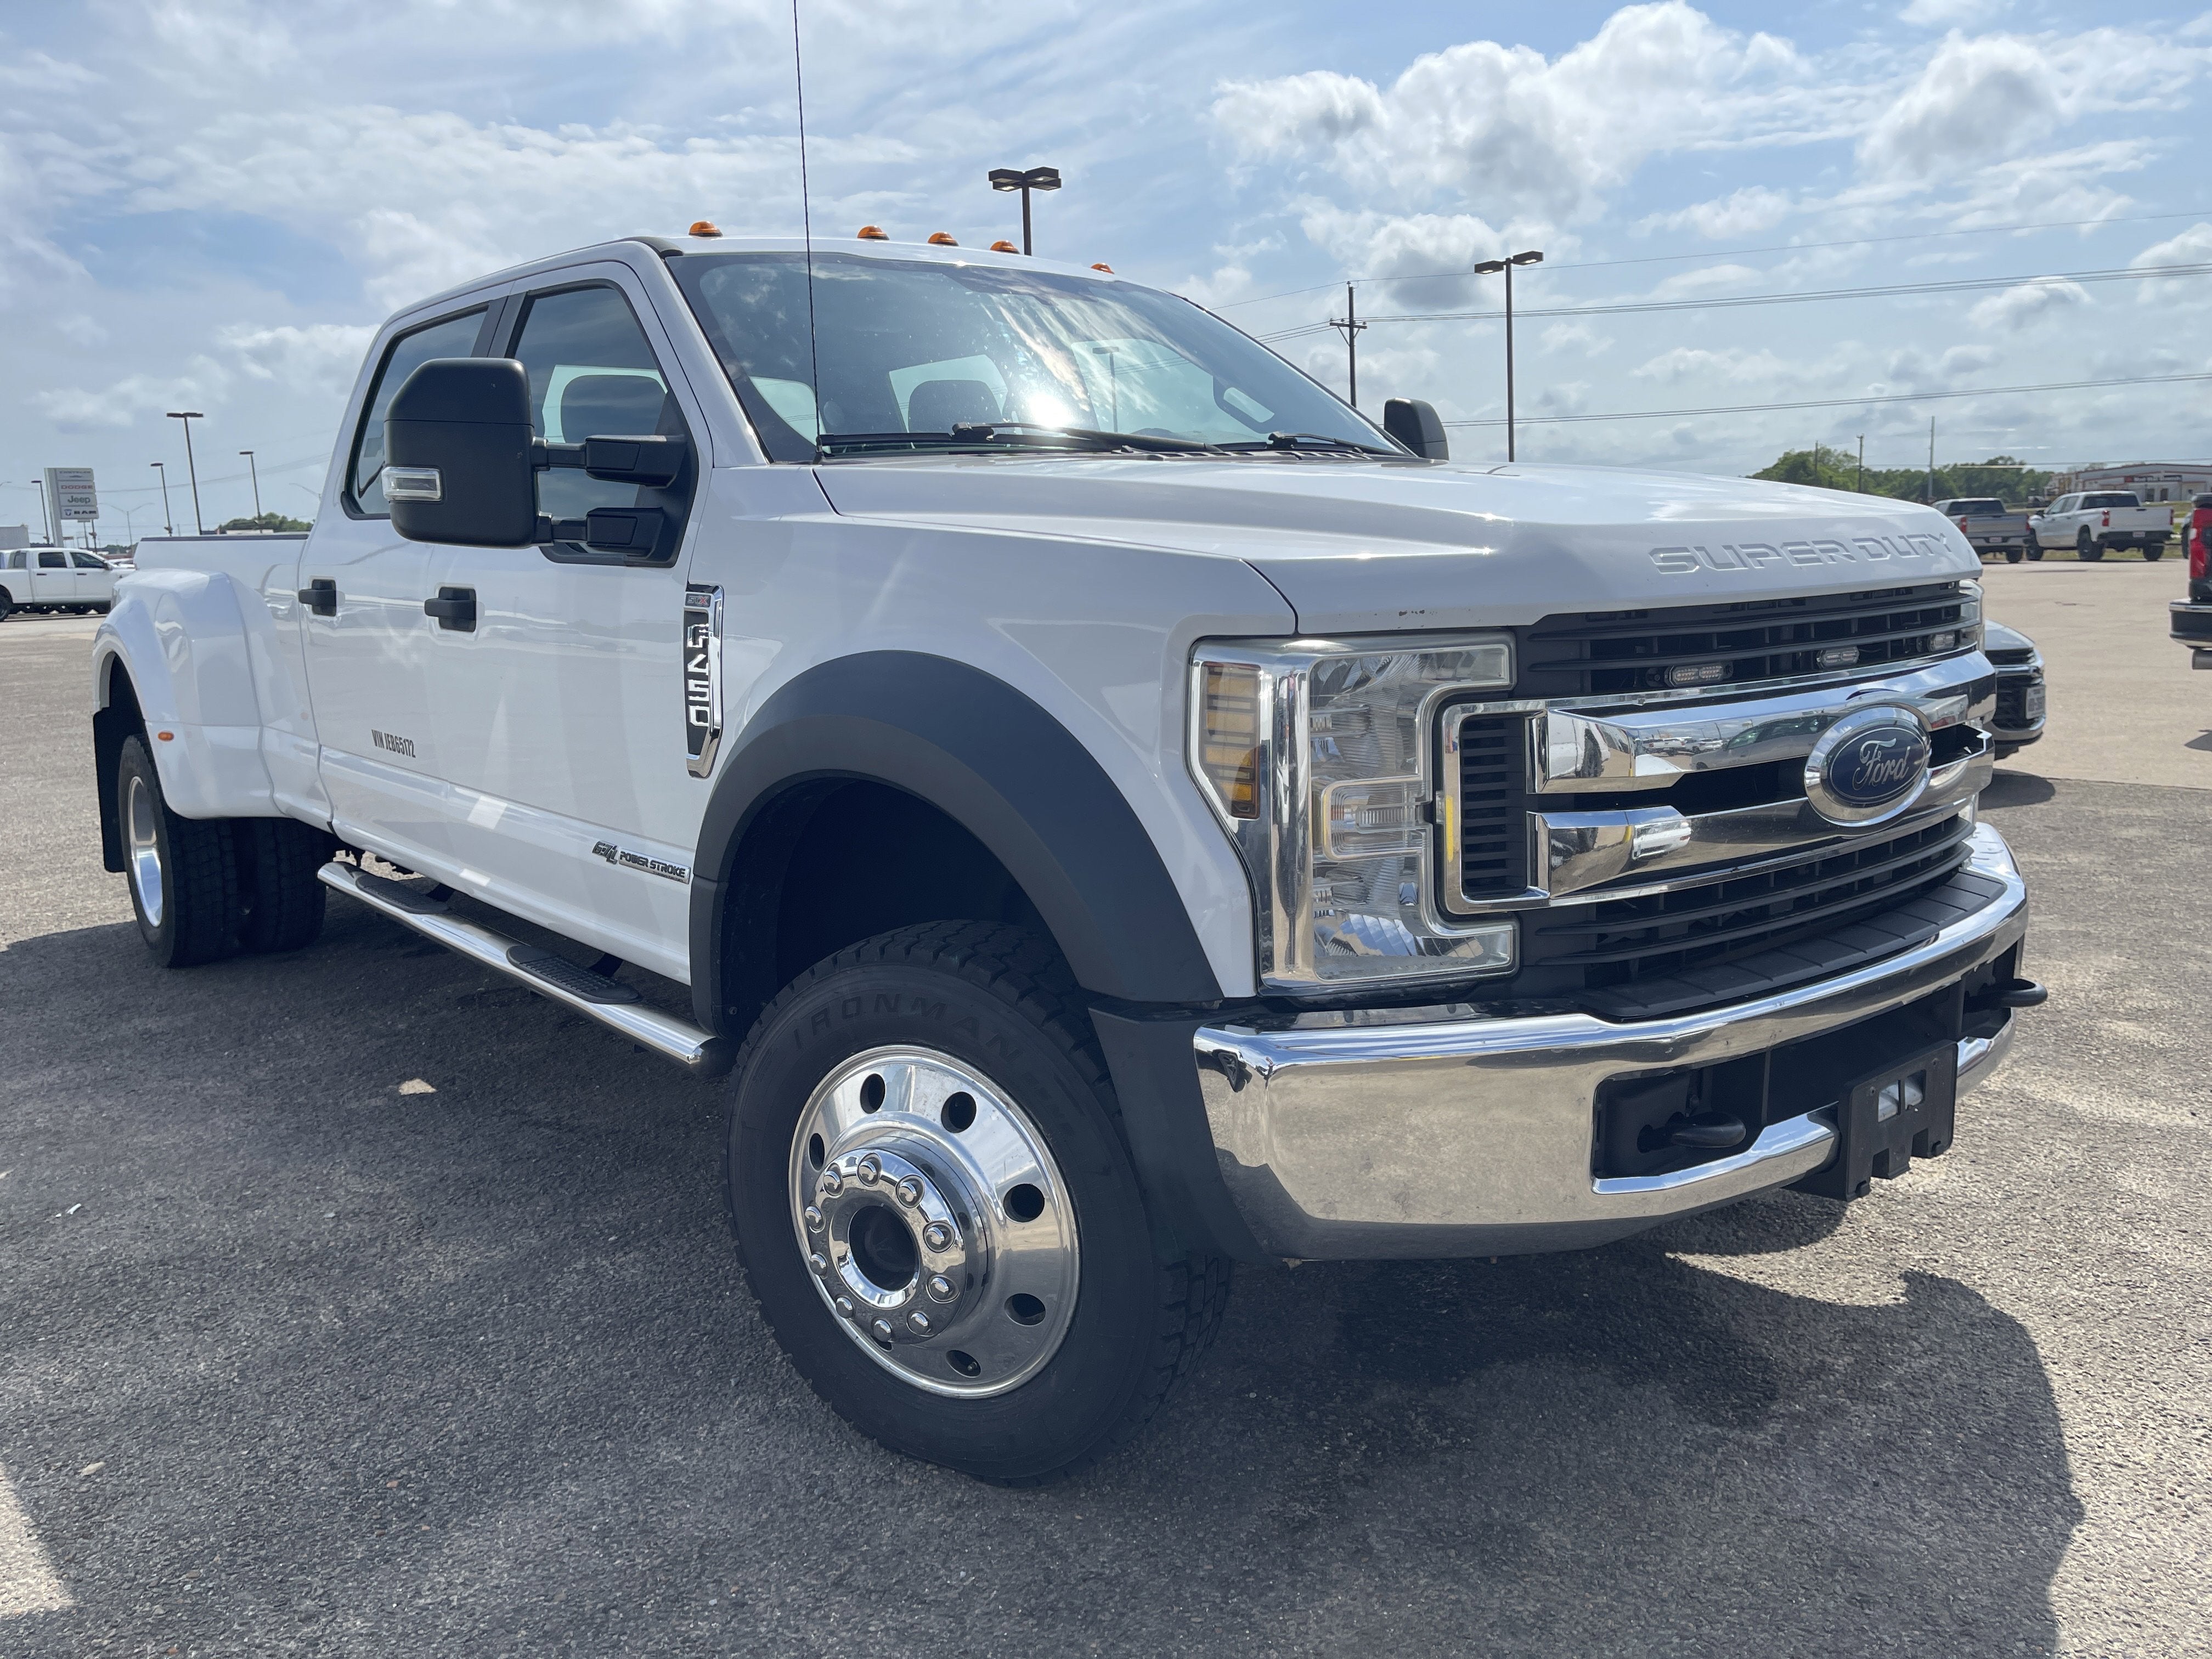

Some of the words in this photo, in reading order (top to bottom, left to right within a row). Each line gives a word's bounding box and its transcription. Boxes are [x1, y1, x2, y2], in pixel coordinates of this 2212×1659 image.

[67, 495, 91, 504] Jeep
[1648, 540, 1856, 574] SUPER
[1852, 533, 1953, 561] DUTY
[687, 595, 710, 606] STX
[371, 729, 385, 749] VIN
[384, 732, 416, 758] JEB65172
[1852, 738, 1910, 791] Ford
[619, 851, 648, 868] POWER
[650, 860, 686, 878] STROKE
[792, 992, 1021, 1063] IRONMAN
